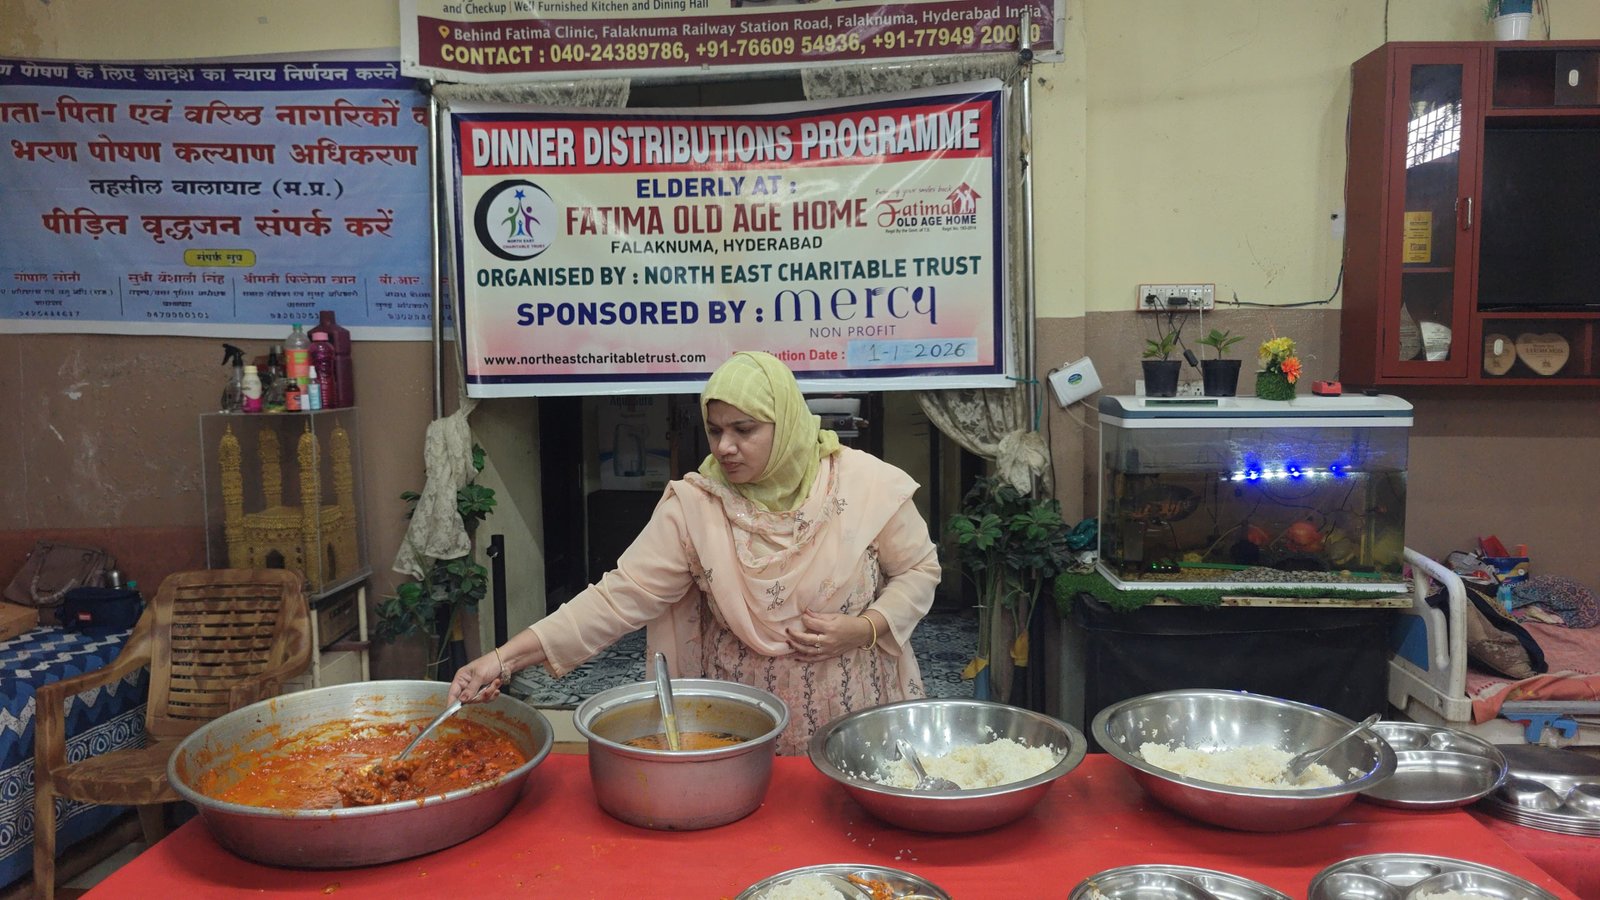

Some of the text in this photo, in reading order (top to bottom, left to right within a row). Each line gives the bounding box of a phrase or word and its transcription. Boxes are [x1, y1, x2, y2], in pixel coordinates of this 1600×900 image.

[443, 3, 462, 14] and
[465, 3, 507, 16] Checkup
[514, 2, 535, 12] Well
[538, 1, 588, 12] Furnished
[591, 0, 629, 11] Kitchen
[631, 0, 650, 11] and
[653, 0, 685, 11] Dining
[454, 28, 501, 42] Behind
[505, 28, 551, 41] Fatima
[555, 25, 598, 40] Clinic,
[602, 24, 678, 38] Falaknuma
[683, 22, 736, 37] Railway
[740, 18, 789, 34] Station
[794, 15, 832, 31] Road,
[837, 12, 918, 28] Falaknuma,
[922, 7, 1001, 24] Hyderabad
[441, 44, 533, 65] CONTACT
[551, 42, 690, 63] 040-24389786,
[696, 37, 795, 58] +91-76609
[801, 32, 866, 54] 54936,
[872, 26, 975, 49] +91-77949
[980, 24, 1041, 44] 2000
[21, 61, 69, 79] पोषण
[75, 63, 94, 80] के
[100, 64, 136, 82] लिए
[144, 66, 195, 84] आदेश
[202, 67, 225, 81] का
[234, 67, 276, 82] न्याय
[355, 63, 398, 81] करने
[129, 99, 172, 125] एवं
[185, 100, 264, 127] वरिष्ठ
[275, 98, 400, 128] नागरिकों
[11, 134, 418, 166] भरण पोषण कल्याण अधिकरण
[472, 108, 981, 168] DINNER DISTRIBUTIONS PROGRAMME
[89, 174, 162, 198] तहसील
[636, 175, 745, 199] ELDERLY
[752, 175, 782, 196] AT
[42, 206, 393, 244] पीड़ित वृद्धजन संपर्क करें
[566, 198, 868, 236] FATIMA OLD AGE HOME
[876, 199, 952, 228] Fatima
[897, 215, 977, 227] OLD AGE HOME
[611, 236, 823, 255] FALAKNUMA, HYDERABAD
[477, 267, 594, 287] ORGANISED
[600, 266, 626, 285] BY
[644, 265, 715, 285] NORTH
[721, 263, 772, 284] EAST
[778, 258, 907, 282] CHARITABLE
[913, 255, 982, 277] TRUST
[516, 301, 699, 327] SPONSORED
[708, 299, 747, 325] BY
[774, 285, 938, 326] mercy
[810, 325, 897, 339] NON PROFIT
[484, 352, 706, 366] www.northeastcharitabletrust.com
[809, 349, 838, 361] Date
[914, 342, 968, 358] 2026
